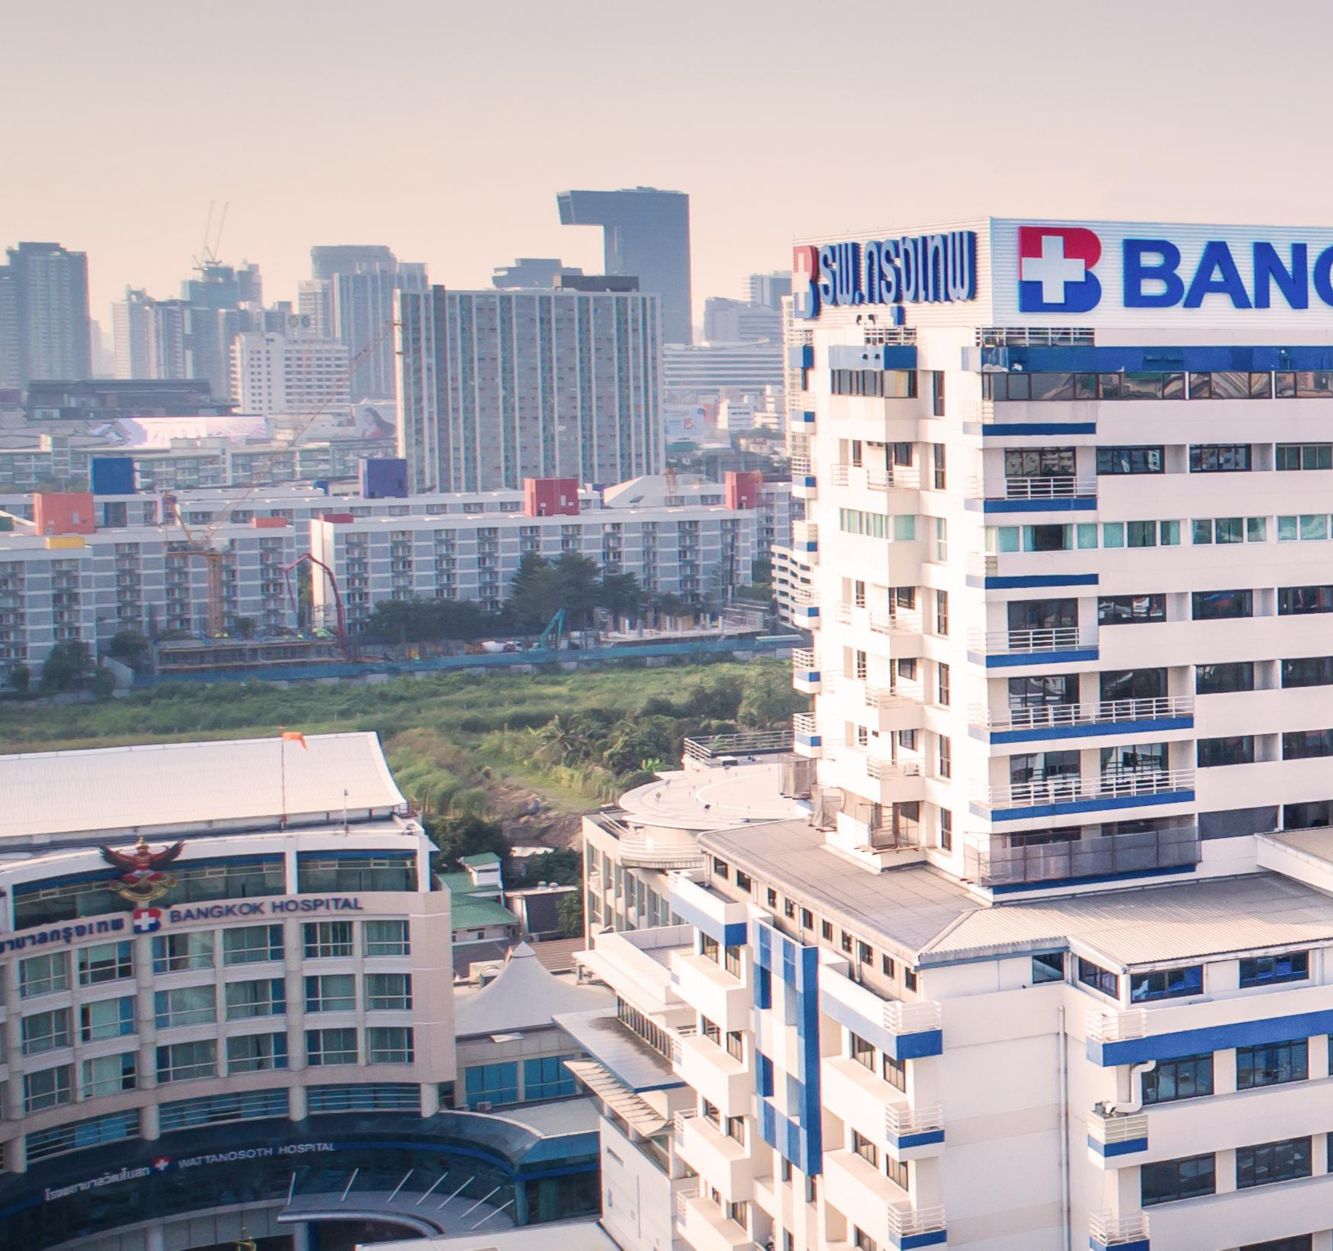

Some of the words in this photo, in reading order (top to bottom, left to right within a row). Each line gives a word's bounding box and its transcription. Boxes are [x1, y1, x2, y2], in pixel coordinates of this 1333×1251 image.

[169, 901, 265, 923] BANGKOK
[272, 897, 364, 914] HOSPITAL
[178, 1147, 273, 1169] WATTANOSOTH
[278, 1143, 336, 1155] HOSPITAL
